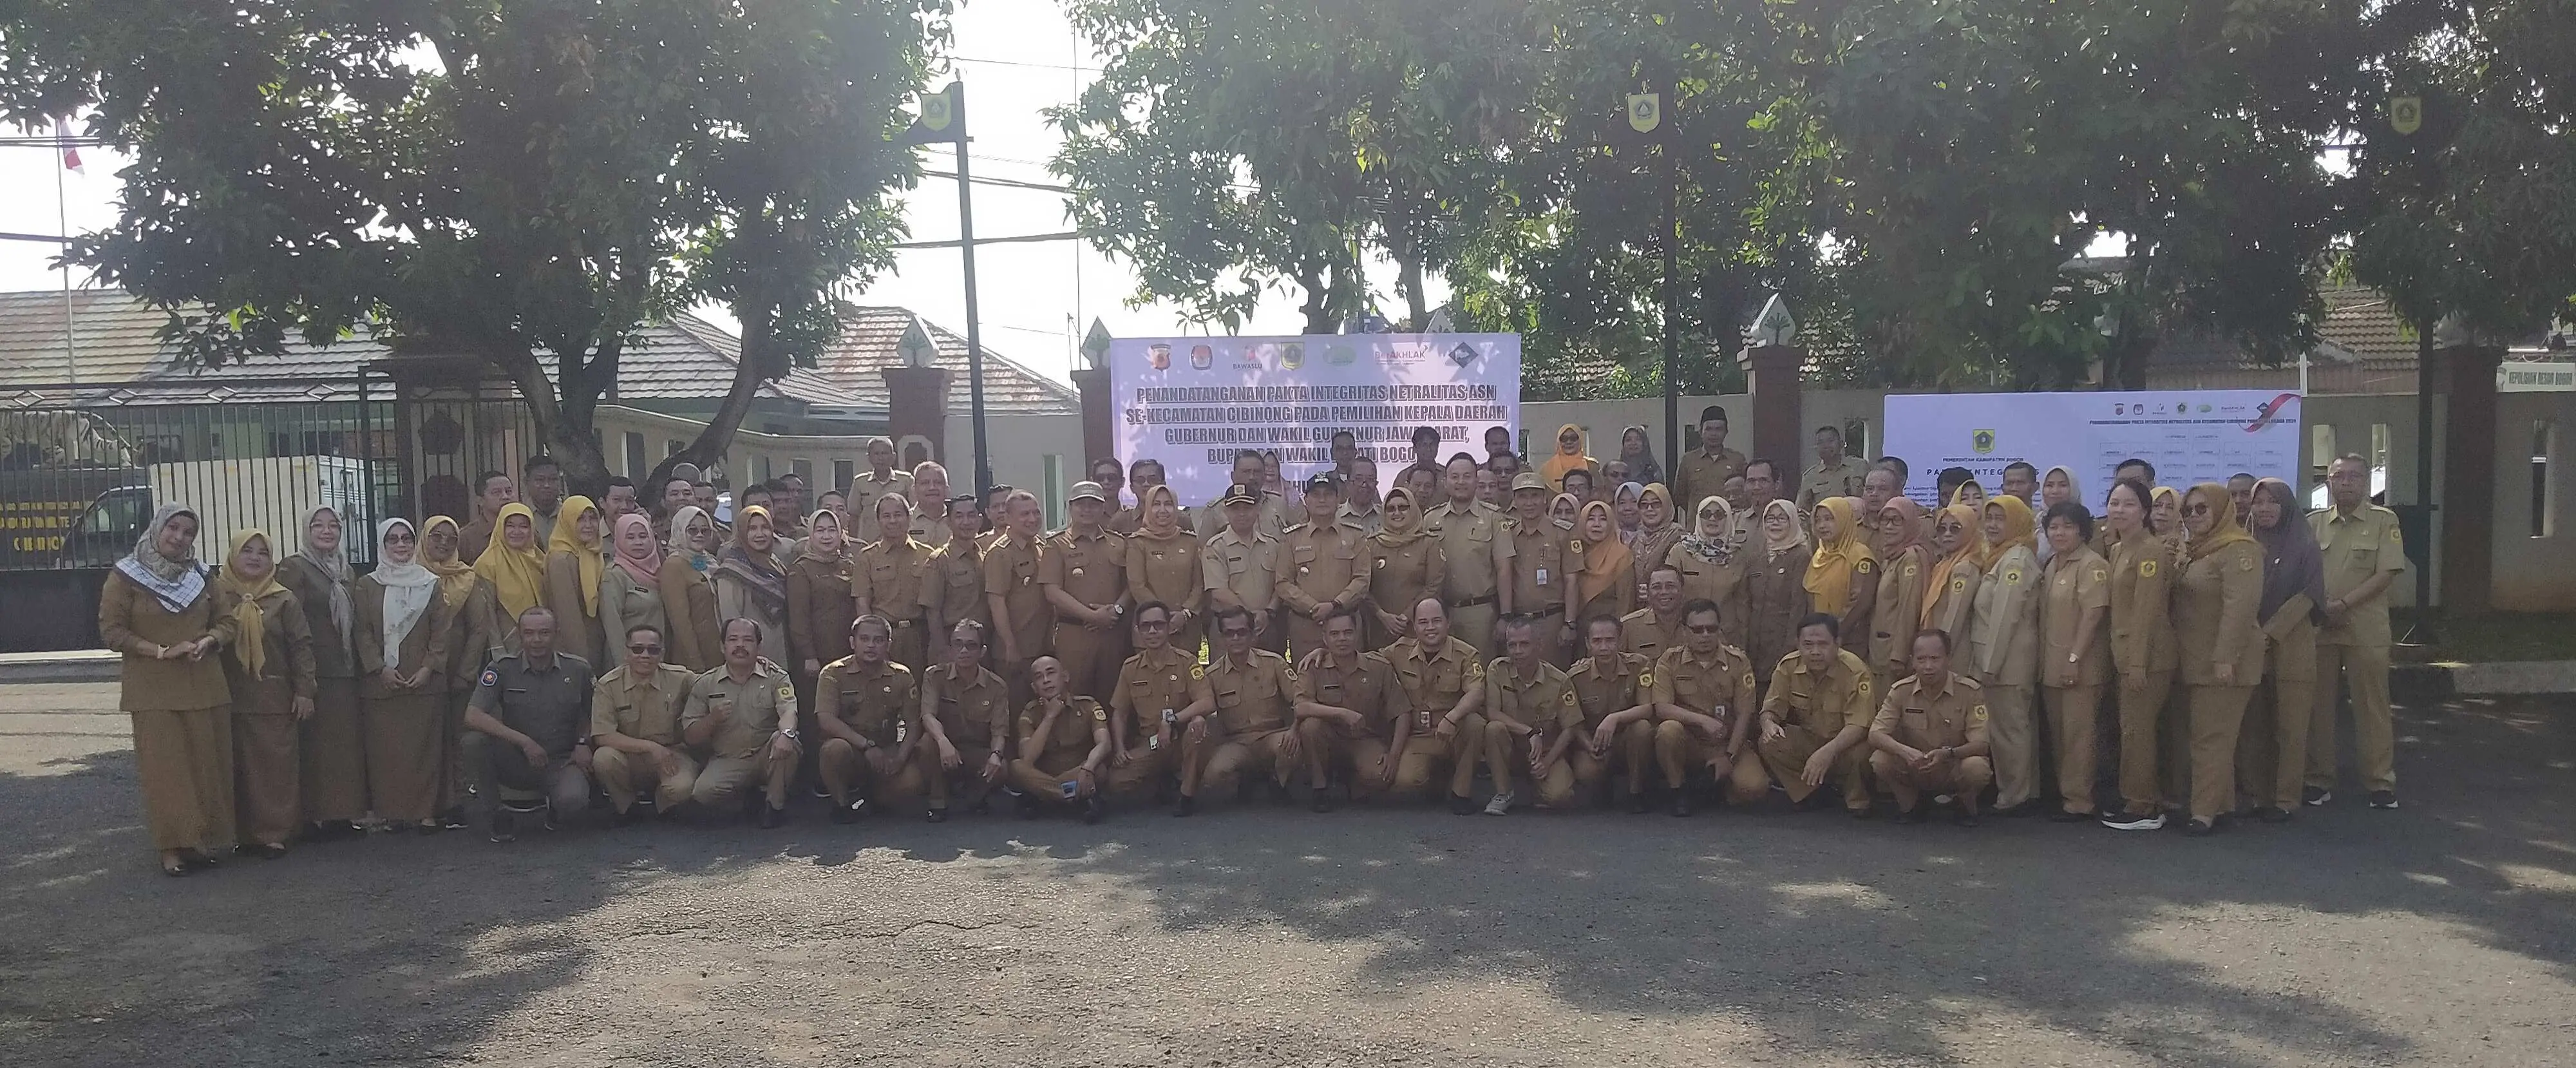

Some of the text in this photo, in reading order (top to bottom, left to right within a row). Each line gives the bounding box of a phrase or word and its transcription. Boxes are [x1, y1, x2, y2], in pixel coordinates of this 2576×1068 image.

[1137, 385, 1497, 403] PENANDATANGANAN PAKTA INTEGRITAS NETRALITAS ASN
[1126, 405, 1508, 424] SE-KECAMATAN CIBINONG PADA PEMILIHAN KEPALA DAERAH
[1165, 428, 1237, 444] GUBERNUR
[1238, 428, 1266, 444] DAN
[1267, 427, 1311, 443] WAKIL
[1385, 426, 1419, 442] JAW
[1208, 448, 1253, 464] BUP
[1285, 447, 1330, 463] WAKIL
[1379, 446, 1417, 462] BOGO
